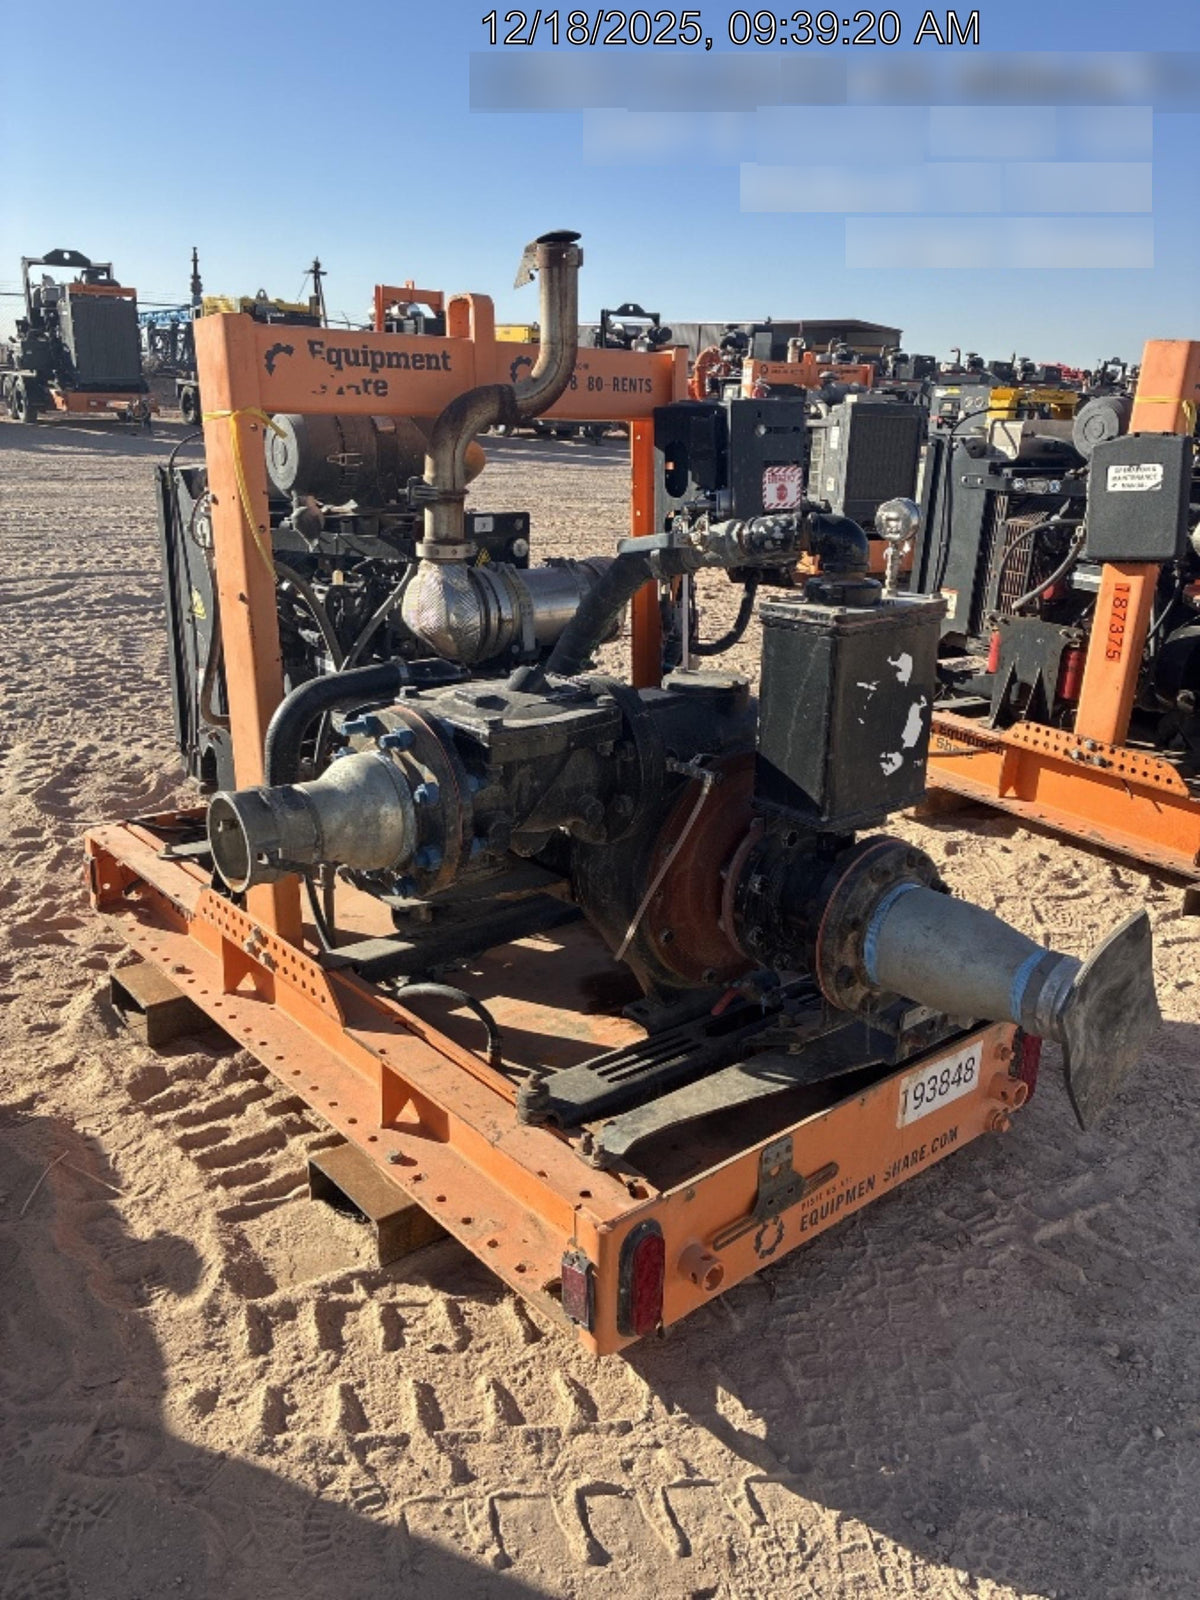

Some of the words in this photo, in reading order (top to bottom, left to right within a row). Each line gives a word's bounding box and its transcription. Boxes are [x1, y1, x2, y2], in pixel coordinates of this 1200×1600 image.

[307, 340, 452, 373] Equipment
[1105, 584, 1131, 660] 187375
[901, 1056, 976, 1116] 193848
